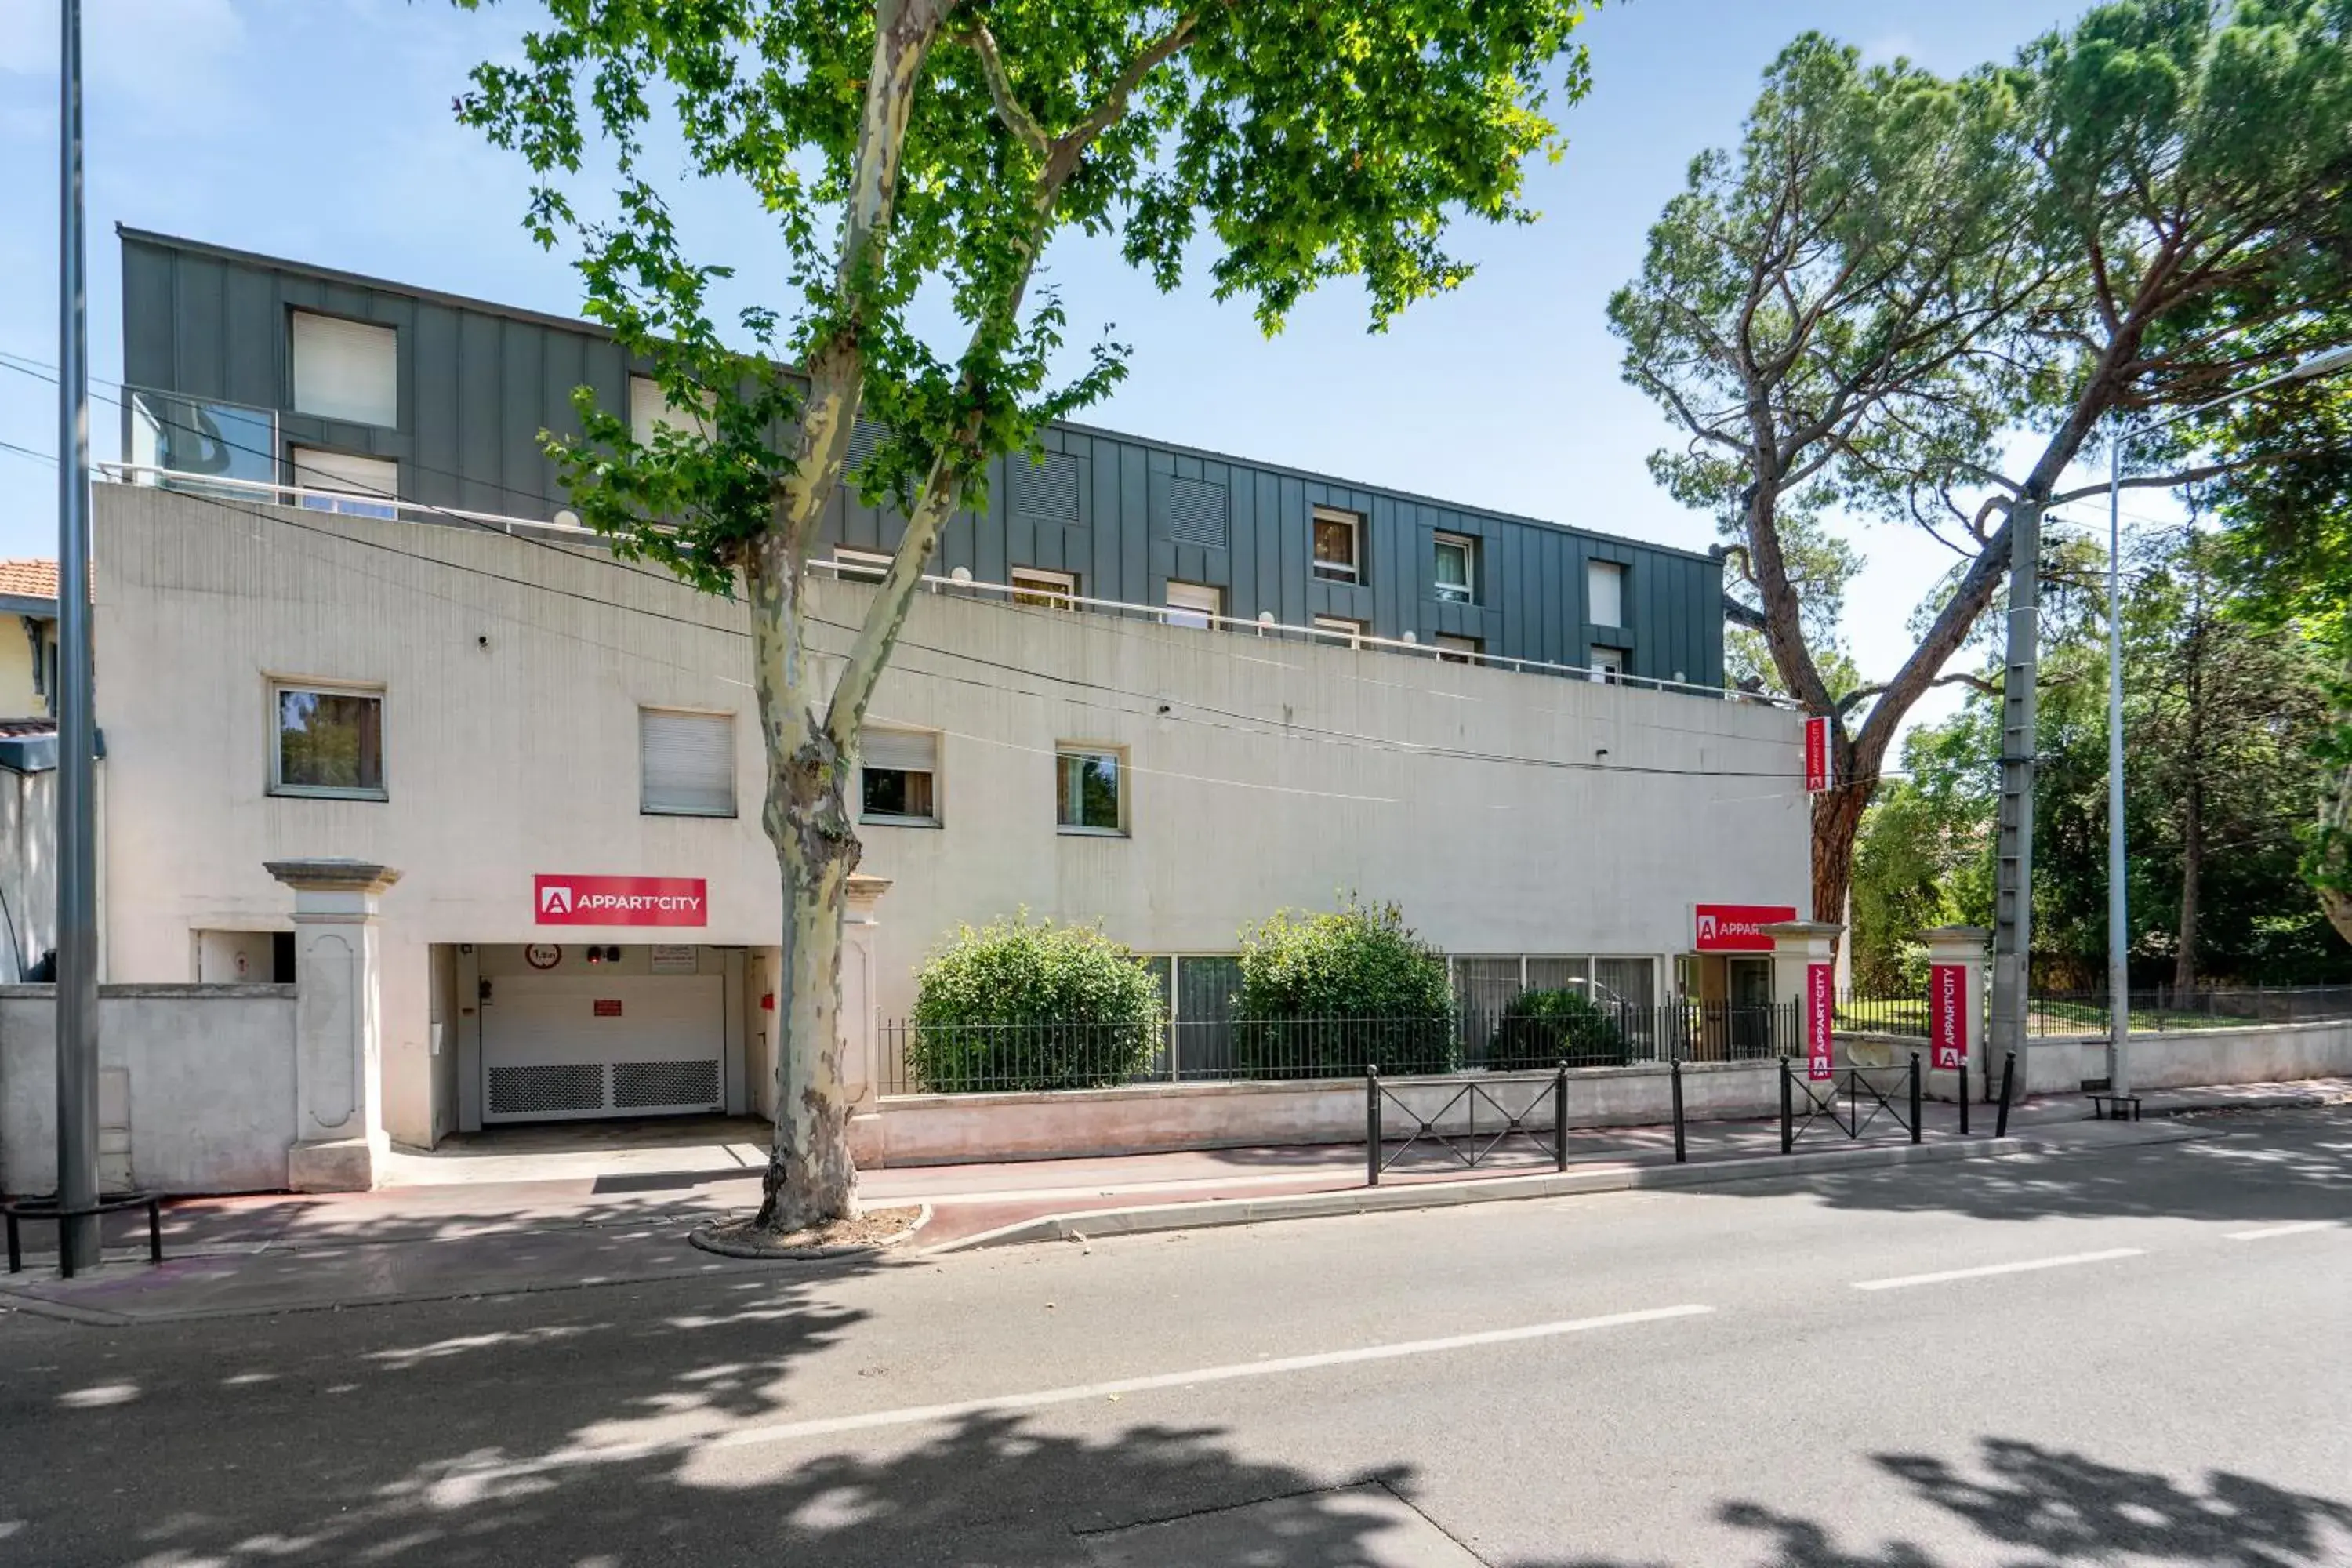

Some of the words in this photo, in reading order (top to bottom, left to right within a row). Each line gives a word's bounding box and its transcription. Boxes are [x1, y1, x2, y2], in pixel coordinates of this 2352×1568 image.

[544, 889, 570, 913] A
[577, 895, 701, 911] APPART'CITY
[1700, 918, 1715, 940] A
[1817, 968, 1825, 1053] APPART'CITY
[1944, 968, 1955, 1046] APPART'CITY
[1941, 1050, 1957, 1067] A
